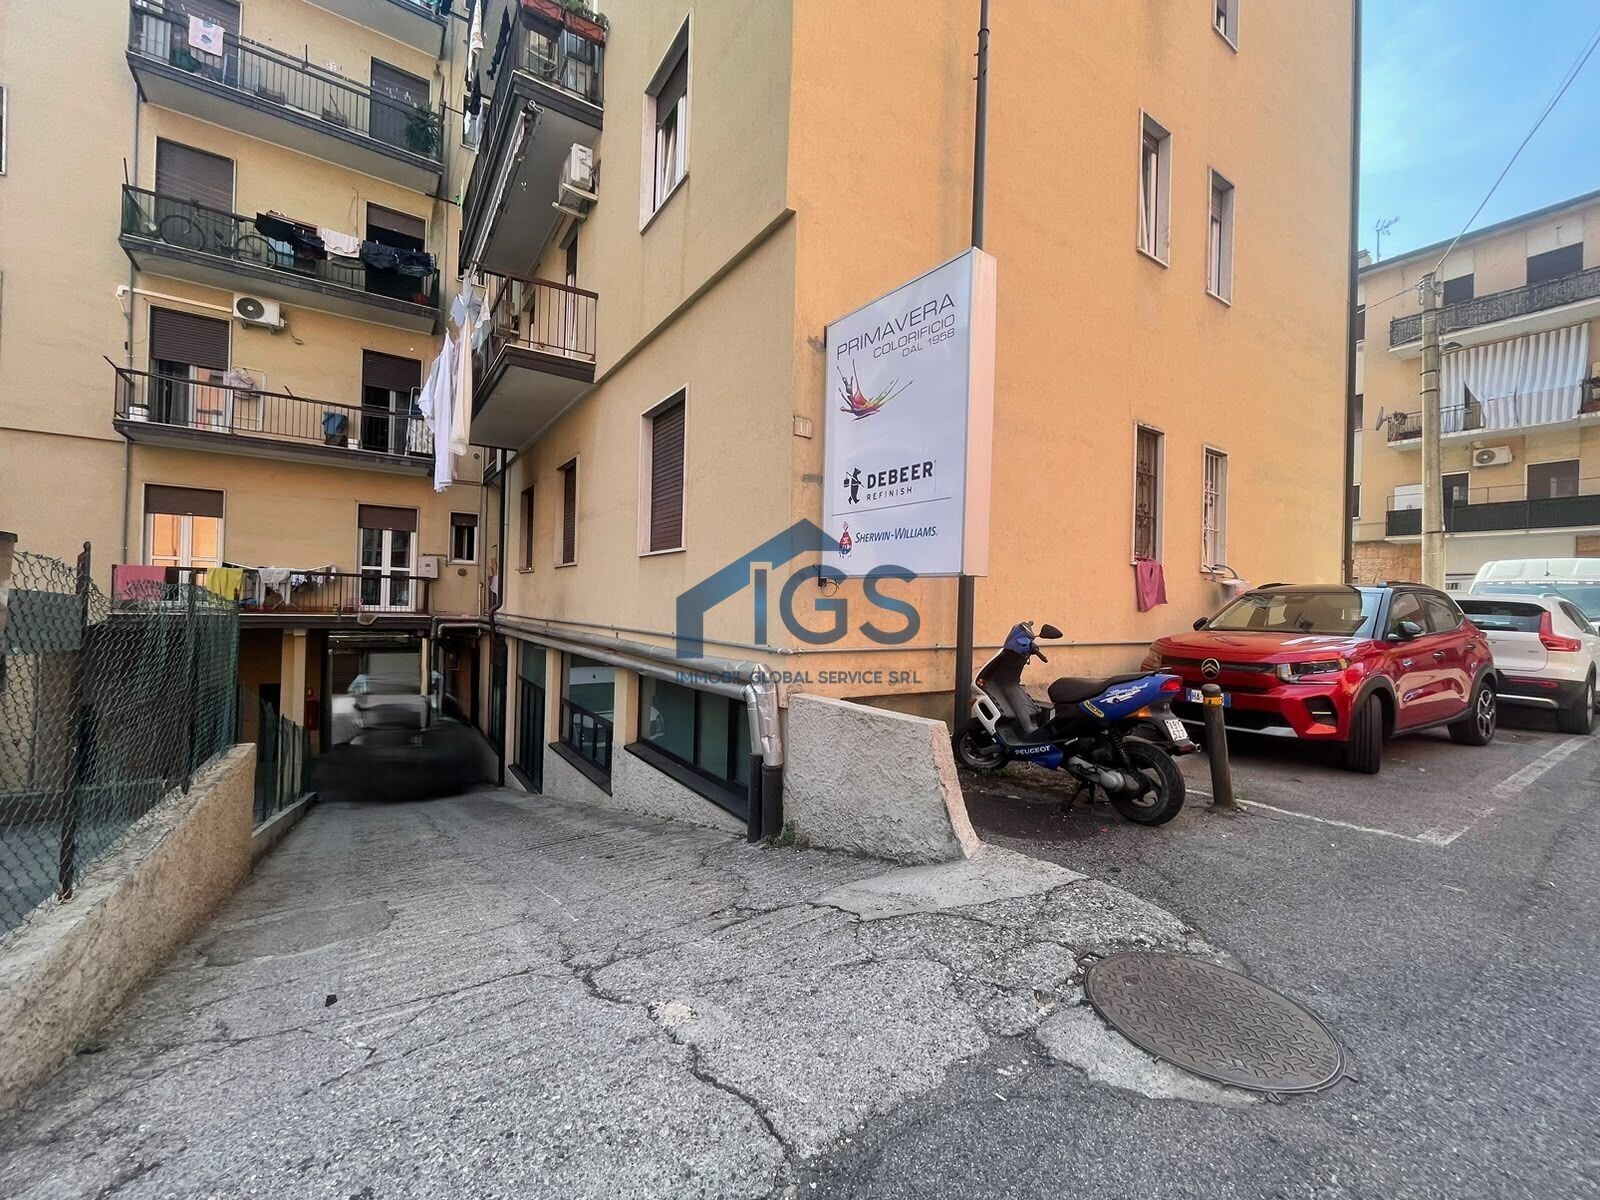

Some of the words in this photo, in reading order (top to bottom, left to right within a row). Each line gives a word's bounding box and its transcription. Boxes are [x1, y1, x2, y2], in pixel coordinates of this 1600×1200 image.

[837, 293, 955, 360] PRIMAVERA
[873, 314, 956, 359] COLORIFICIO
[902, 344, 923, 357] DAL
[928, 327, 956, 346] 1958
[867, 460, 934, 489] DEBEER
[866, 486, 913, 501] REFINISH
[1015, 745, 1050, 755] PEUGEOT
